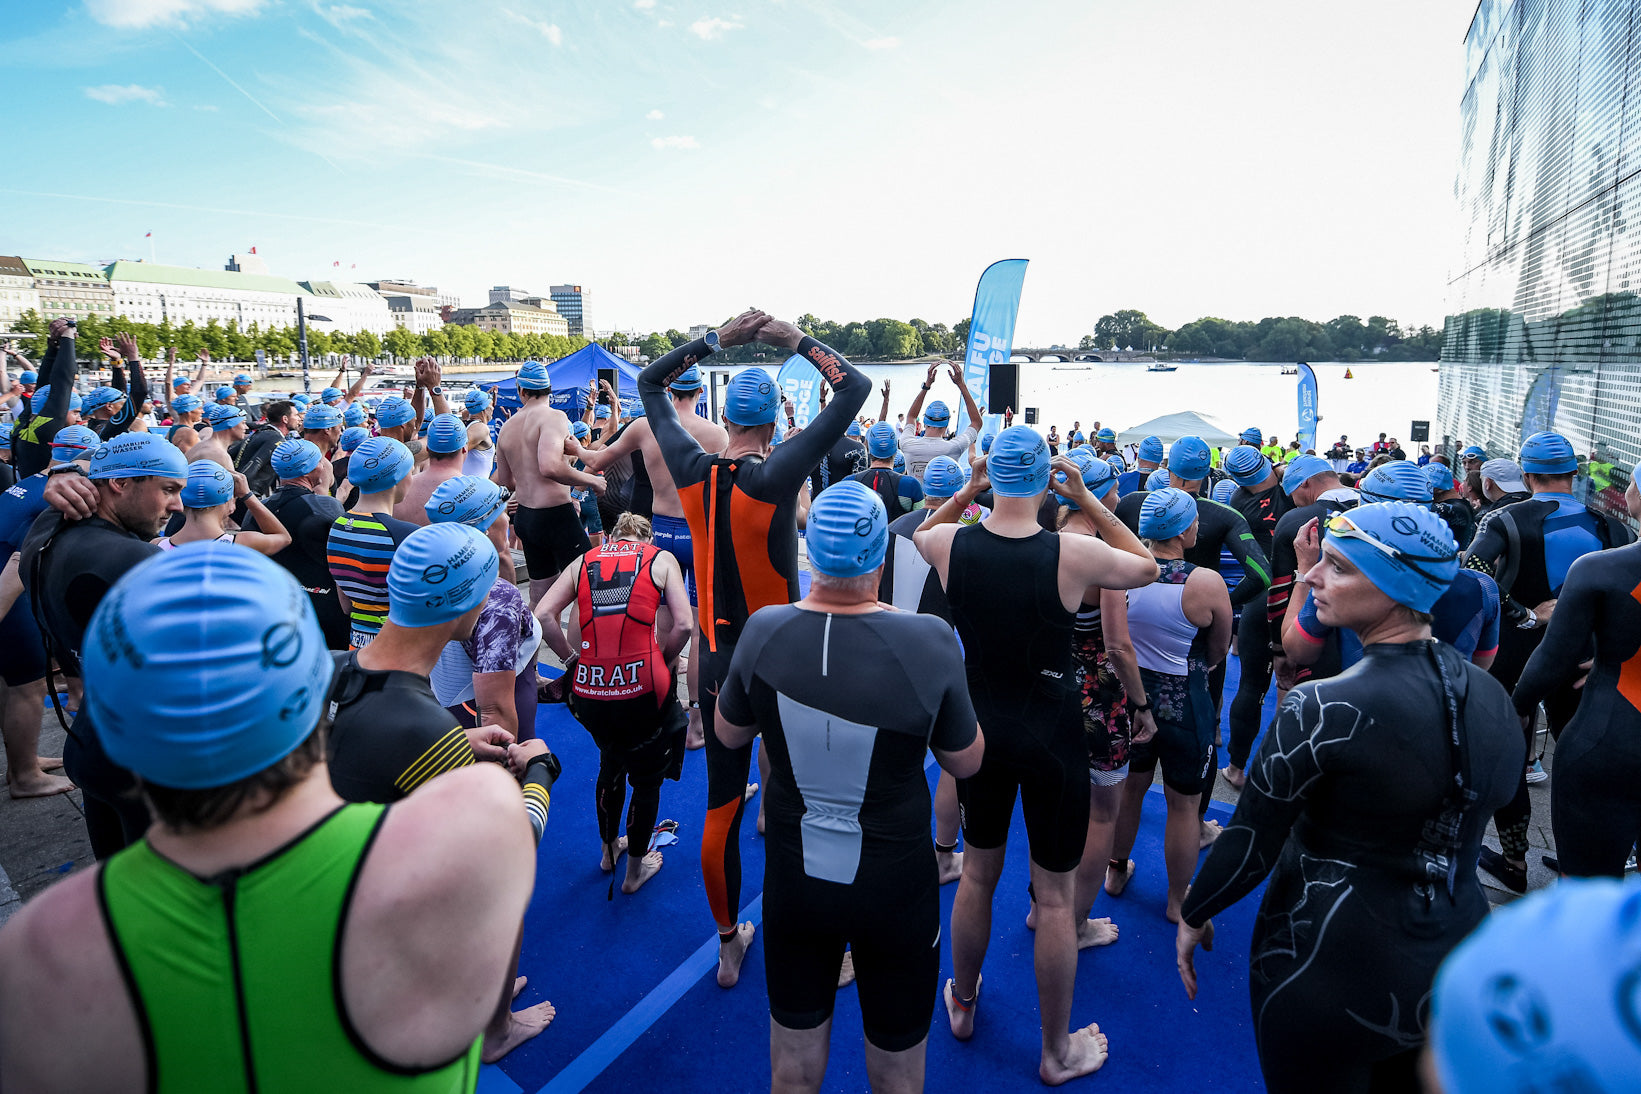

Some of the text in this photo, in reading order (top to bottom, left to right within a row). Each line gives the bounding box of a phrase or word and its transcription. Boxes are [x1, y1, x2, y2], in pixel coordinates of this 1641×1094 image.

[807, 346, 848, 385] sailfish
[112, 445, 144, 455] WASSER
[600, 542, 641, 553] BRAT
[575, 659, 645, 688] BRAT
[574, 684, 644, 697] www.bratclub.co.uk
